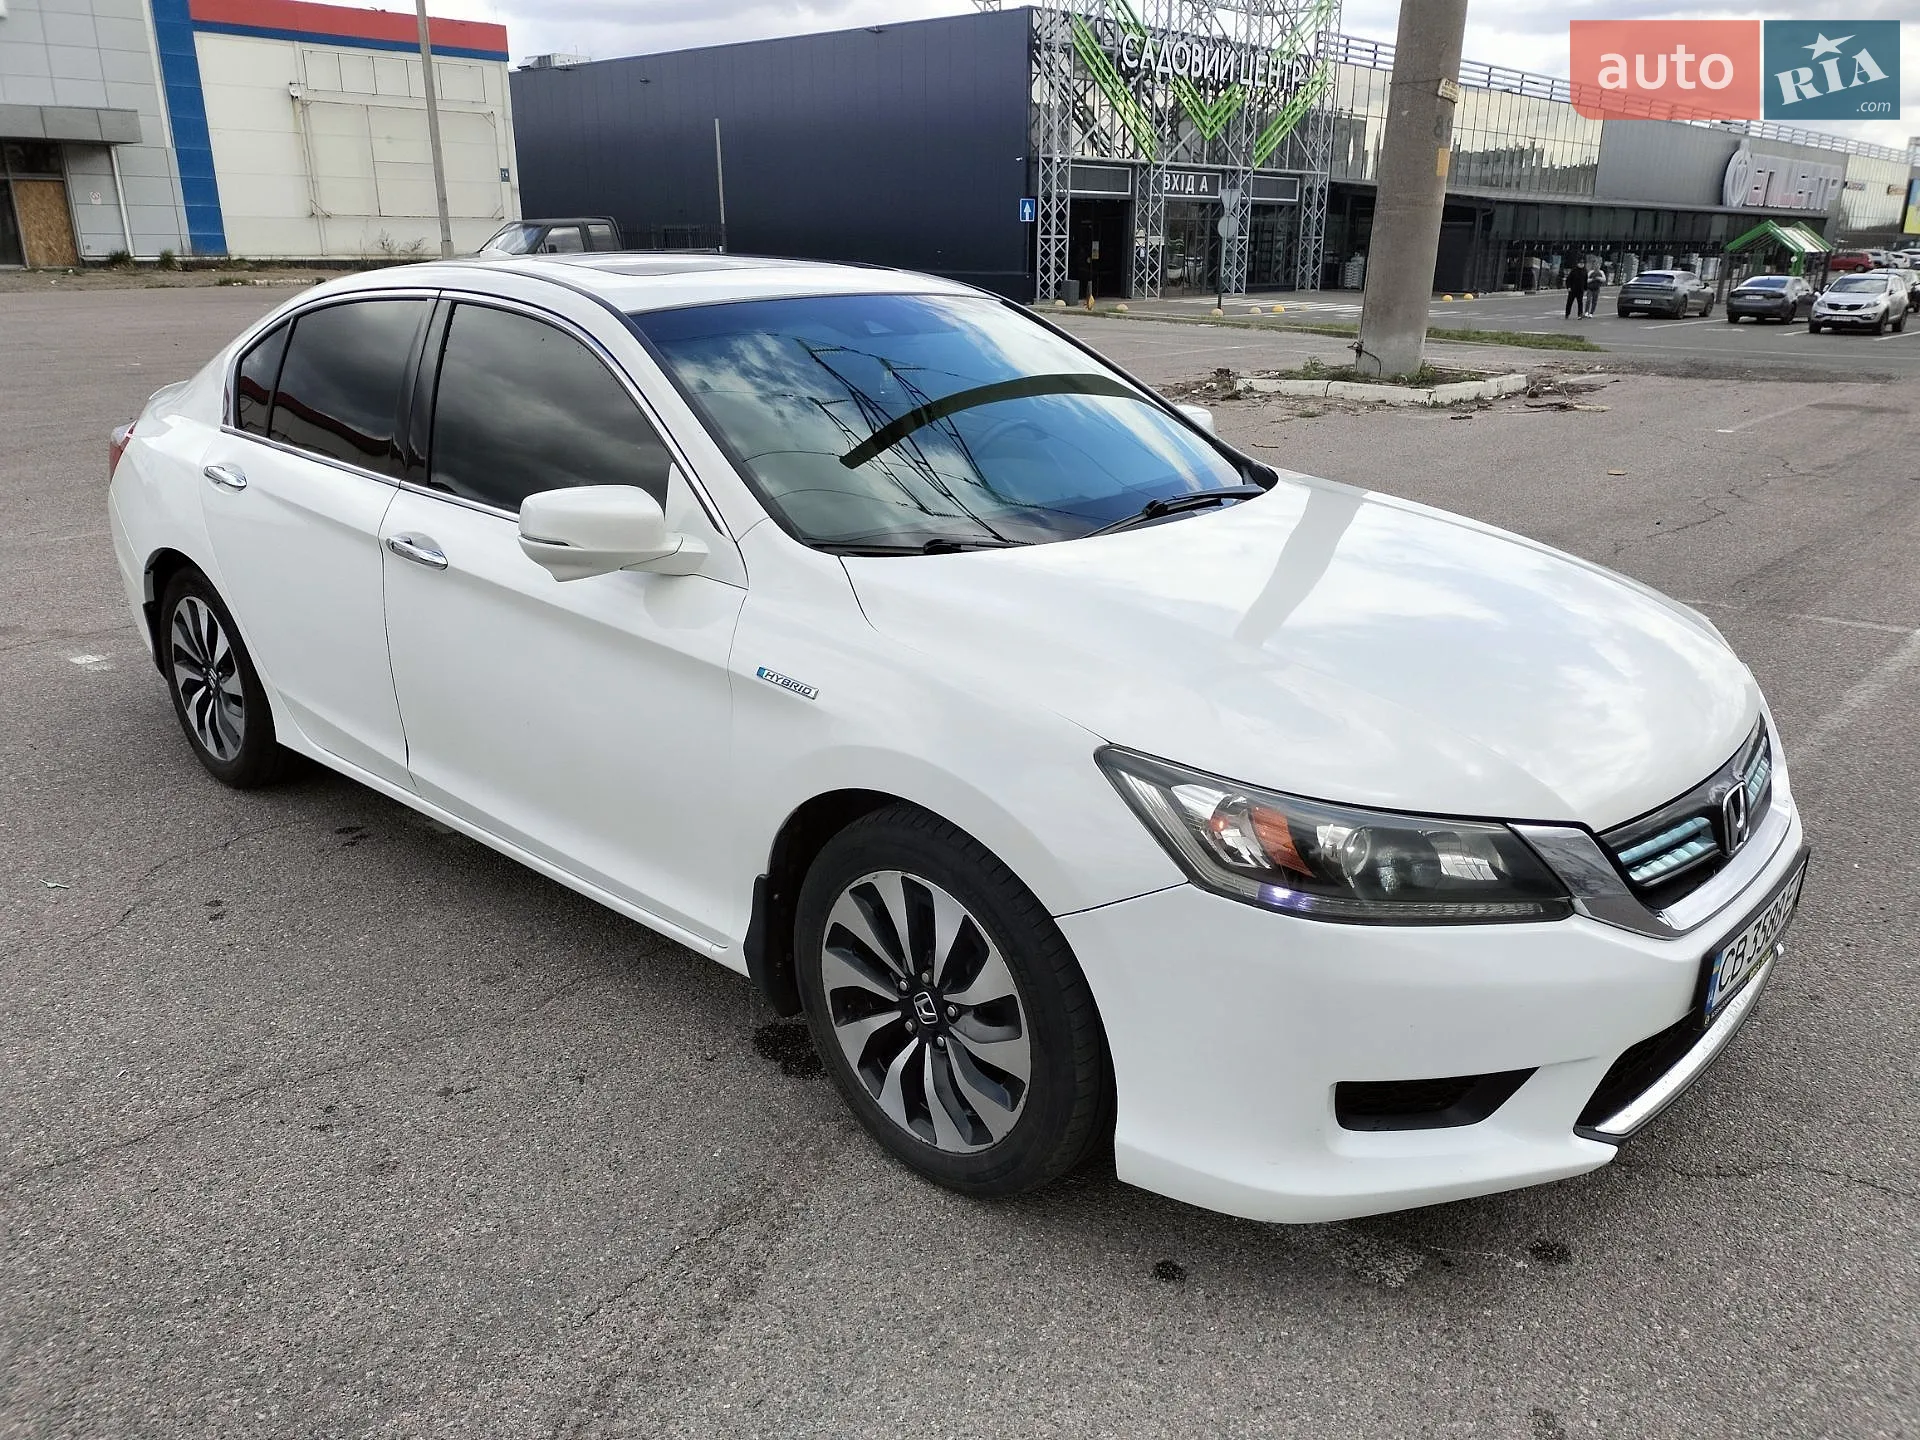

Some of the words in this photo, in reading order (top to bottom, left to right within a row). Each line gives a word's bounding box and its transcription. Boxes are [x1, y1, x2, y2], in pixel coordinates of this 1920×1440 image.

[1122, 33, 1235, 83] САДОВИЙ
[1239, 49, 1303, 96] ЦЕНТР
[1164, 174, 1195, 194] ВХІД
[1200, 176, 1208, 192] А
[765, 671, 812, 695] HYBRID
[1719, 934, 1748, 992] CB
